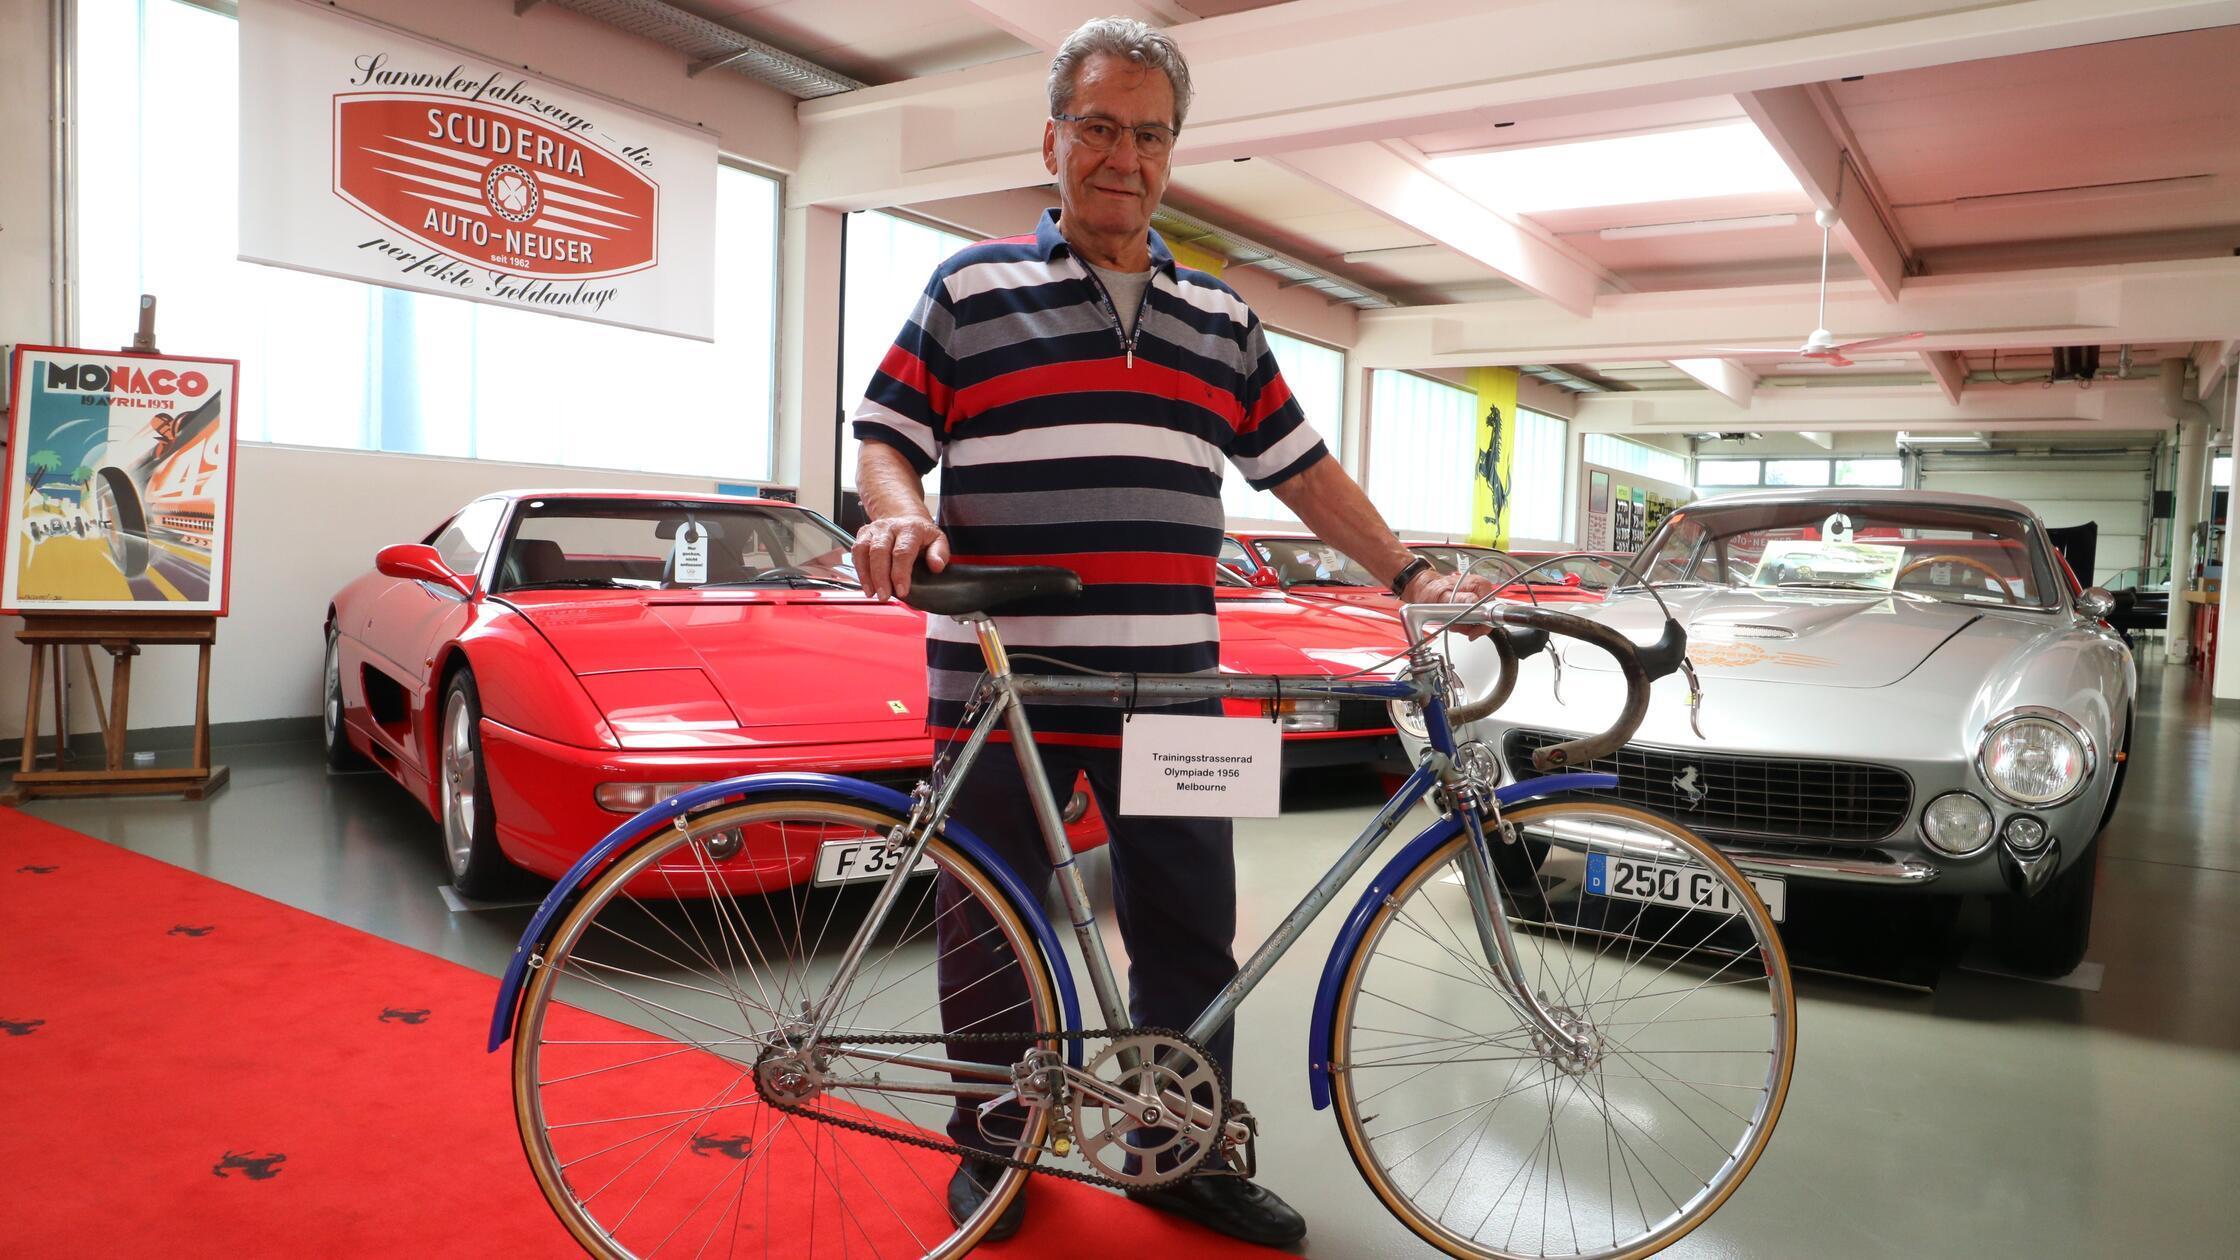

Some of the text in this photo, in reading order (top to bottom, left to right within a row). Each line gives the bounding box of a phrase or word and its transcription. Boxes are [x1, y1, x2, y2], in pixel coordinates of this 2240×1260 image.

[350, 52, 594, 133] Sammlerfahrzeuge
[622, 144, 655, 170] die
[428, 108, 586, 178] SCUDERIA
[424, 208, 593, 264] AUTO-NEUSER
[357, 238, 618, 312] perfekte Geldanlage
[491, 253, 531, 269] seit 1962
[48, 361, 209, 398] MONACO
[81, 395, 174, 410] 19 AVRIL 1931
[1152, 752, 1253, 764] Trainingsstrassenrad
[1164, 767, 1240, 778] Olympiade 1956
[1176, 782, 1227, 792] Melbourne
[836, 846, 923, 876] F 35
[1592, 876, 1601, 887] D
[1613, 862, 1772, 913] 250 GT
